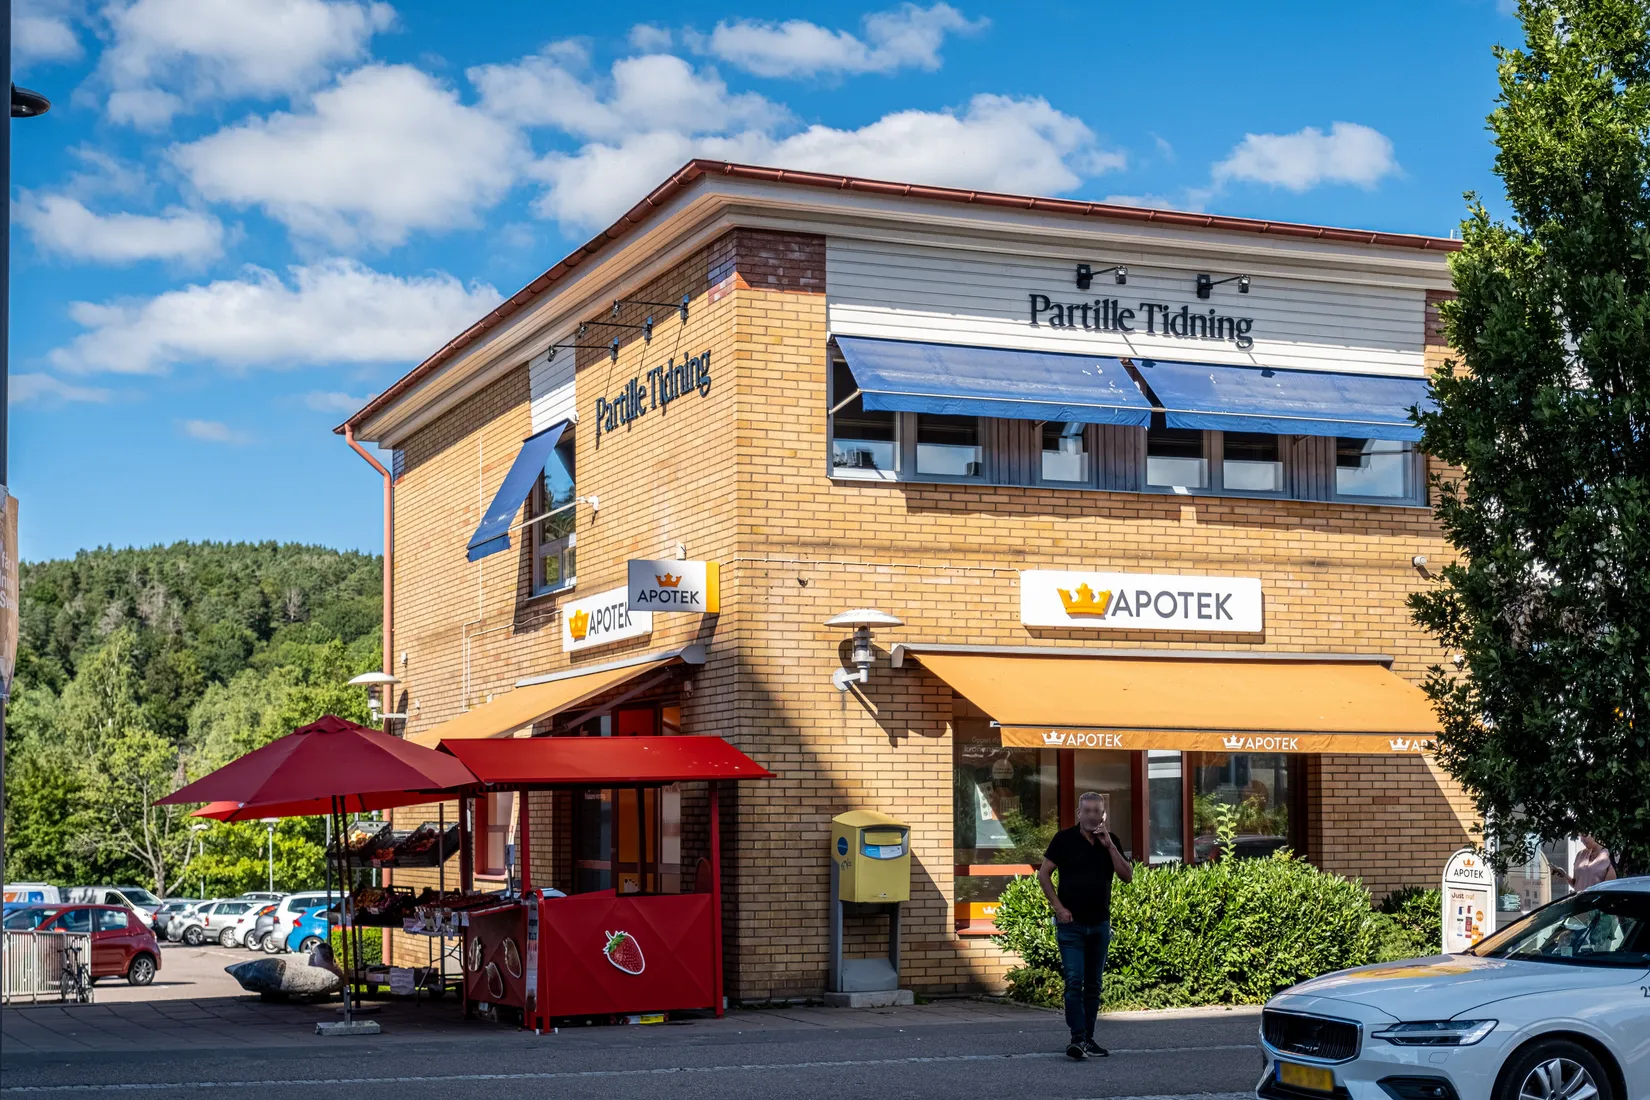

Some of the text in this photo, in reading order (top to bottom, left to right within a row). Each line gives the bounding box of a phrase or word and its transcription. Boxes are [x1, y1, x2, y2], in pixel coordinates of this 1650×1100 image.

[1028, 293, 1254, 348] Partille Tidning
[595, 349, 712, 437] Partille Tidning
[637, 589, 700, 605] APOTEK
[1111, 589, 1234, 620] APOTEK
[588, 601, 632, 636] APOTEK
[1066, 733, 1123, 747] APOTEK
[1245, 736, 1298, 750] APOTEK
[1453, 868, 1484, 879] APOTEK
[1451, 892, 1464, 900] Just
